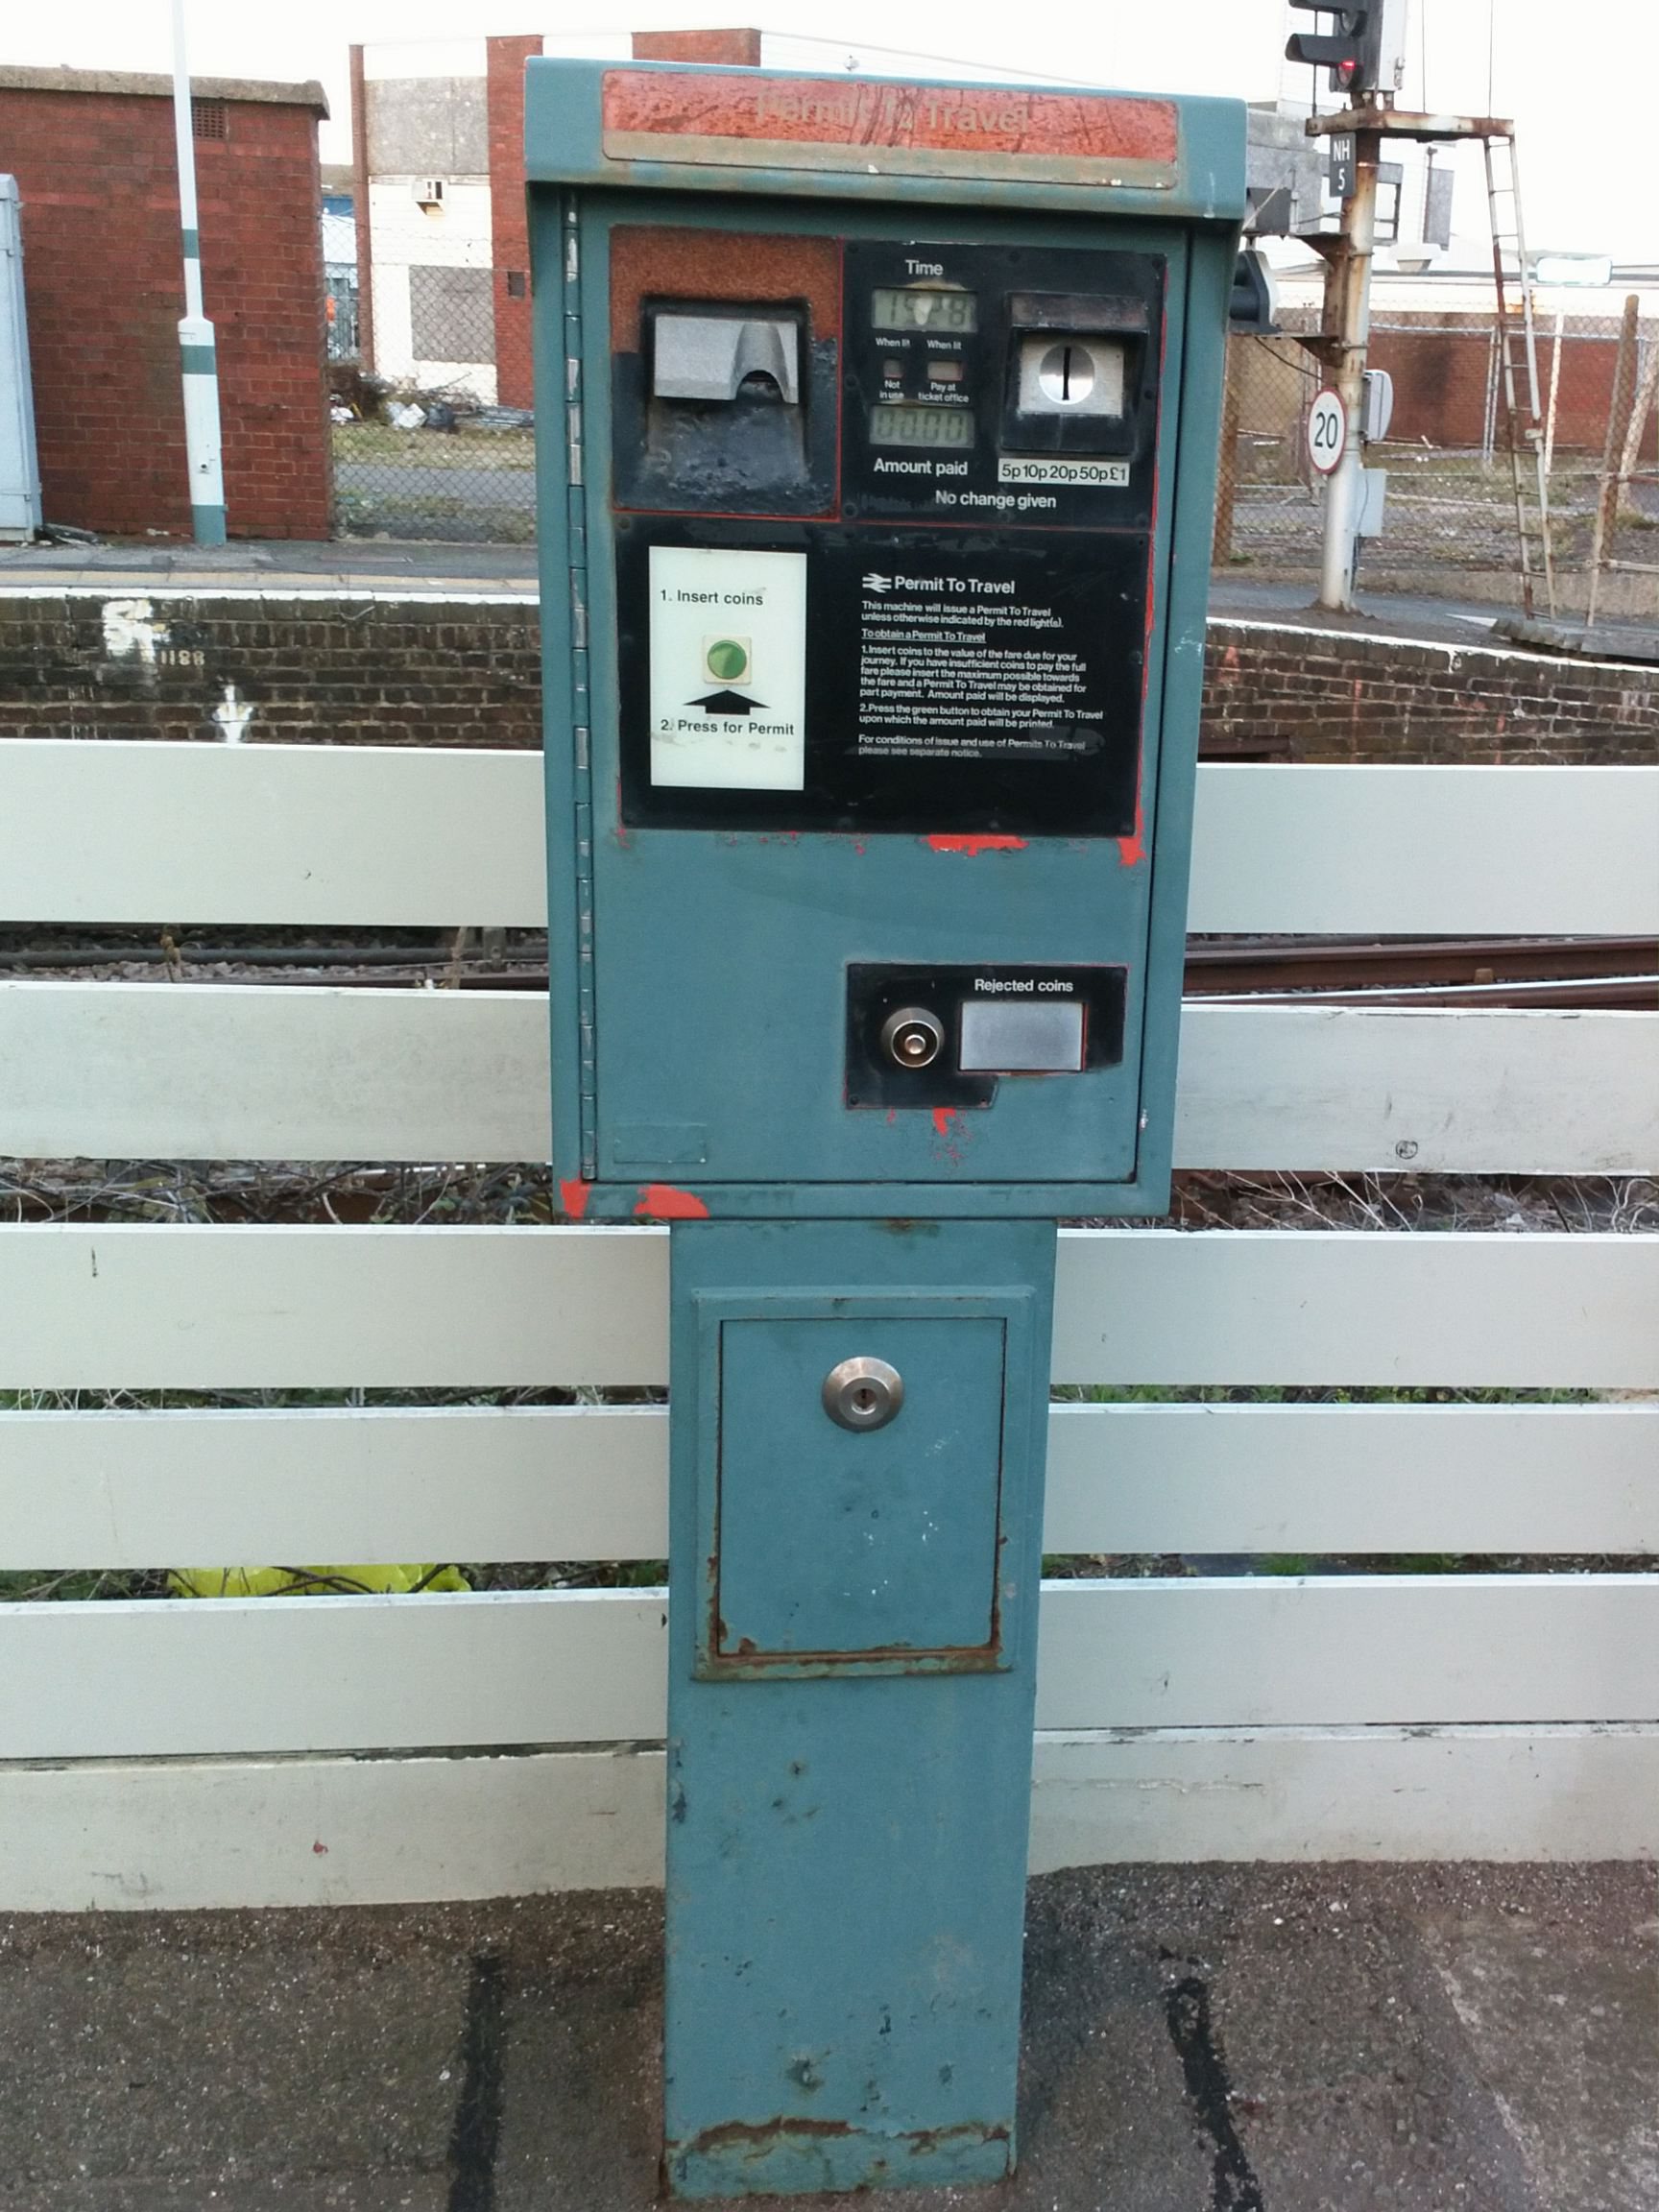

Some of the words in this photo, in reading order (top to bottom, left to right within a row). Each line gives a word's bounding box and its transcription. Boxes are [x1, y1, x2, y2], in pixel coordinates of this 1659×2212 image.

[926, 99, 1028, 133] Travel
[1334, 139, 1350, 161] NH
[1338, 168, 1345, 190] 5
[904, 259, 944, 276] Time
[876, 338, 901, 347] When
[927, 340, 951, 349] When
[884, 380, 900, 389] Not
[931, 382, 946, 393] Pay
[918, 392, 943, 401] ticket
[944, 394, 970, 402] office
[1314, 412, 1338, 449] 20
[874, 458, 932, 474] Amount
[936, 461, 968, 477] paid
[1002, 464, 1021, 479] 5p
[1022, 465, 1047, 481] 10p
[1050, 466, 1078, 482] 20p
[1079, 467, 1108, 483] 50p
[1110, 468, 1126, 481] £1
[936, 490, 956, 504] No
[960, 492, 1015, 510] change
[1018, 493, 1056, 510] given
[895, 576, 944, 590] Permit
[947, 578, 966, 591] To
[968, 579, 1015, 593] Travel
[678, 589, 719, 603] Insert
[724, 592, 763, 606] coins
[862, 601, 882, 610] This
[883, 602, 923, 612] machine
[926, 603, 941, 613] will
[944, 604, 968, 613] issue
[977, 606, 1007, 615] Permit
[1009, 607, 1022, 615] To
[1022, 607, 1051, 616] Travel
[862, 613, 892, 621] unless
[893, 613, 939, 623] otherwise
[941, 615, 983, 625] indicated
[985, 616, 995, 627] by
[998, 617, 1012, 626] the
[1014, 618, 1029, 627] red
[862, 629, 874, 637] To
[876, 629, 903, 638] obtain
[912, 630, 943, 639] Permit
[944, 632, 955, 640] To
[956, 632, 985, 641] Travel
[898, 647, 923, 656] coins
[924, 647, 933, 656] to
[935, 648, 950, 657] the
[950, 649, 974, 658] value
[976, 649, 987, 658] of
[988, 649, 1002, 659] the
[1004, 650, 1022, 659] fare
[1023, 651, 1041, 660] due
[1043, 651, 1055, 660] for
[861, 657, 898, 667] journey.
[901, 657, 906, 665] If
[907, 659, 925, 667] you
[926, 658, 948, 667] have
[949, 659, 998, 669] insufficient
[1000, 661, 1024, 670] coins
[1026, 661, 1036, 670] to
[1056, 662, 1070, 671] the
[1072, 662, 1087, 671] full
[861, 666, 878, 675] fare
[880, 667, 911, 677] please
[913, 668, 939, 677] insert
[941, 669, 955, 678] the
[957, 670, 1001, 679] maximum
[1003, 672, 1042, 681] possible
[1044, 673, 1080, 682] towards
[861, 677, 876, 685] the
[878, 678, 896, 686] fare
[924, 679, 954, 688] Permit
[955, 680, 967, 688] To
[968, 681, 996, 689] Travel
[998, 684, 1017, 692] may
[1019, 683, 1030, 691] be
[1032, 684, 1071, 692] obtained
[881, 690, 924, 699] payment.
[927, 690, 964, 699] Amount
[966, 691, 986, 701] paid
[988, 692, 1004, 701] will
[1005, 692, 1017, 701] be
[1019, 693, 1065, 704] displayed.
[896, 705, 910, 713] the
[912, 707, 938, 715] green
[940, 707, 970, 715] button
[971, 707, 979, 715] to
[981, 708, 1010, 716] obtain
[1033, 709, 1062, 718] Permit
[1064, 709, 1074, 718] To
[1075, 710, 1103, 719] Travel
[678, 720, 718, 733] Press
[724, 722, 743, 733] for
[749, 722, 794, 735] Permit
[884, 715, 911, 724] which
[913, 716, 927, 725] the
[929, 717, 964, 726] amount
[966, 718, 986, 727] paid
[1005, 719, 1017, 728] be
[1020, 720, 1054, 729] printed.
[859, 734, 875, 743] For
[876, 735, 923, 744] conditions
[925, 736, 934, 745] of
[935, 737, 959, 746] issue
[1057, 741, 1086, 750] Travel
[859, 747, 889, 756] please
[951, 749, 982, 757] notice.
[974, 979, 1034, 994] Rejected
[1038, 979, 1073, 992] coins
